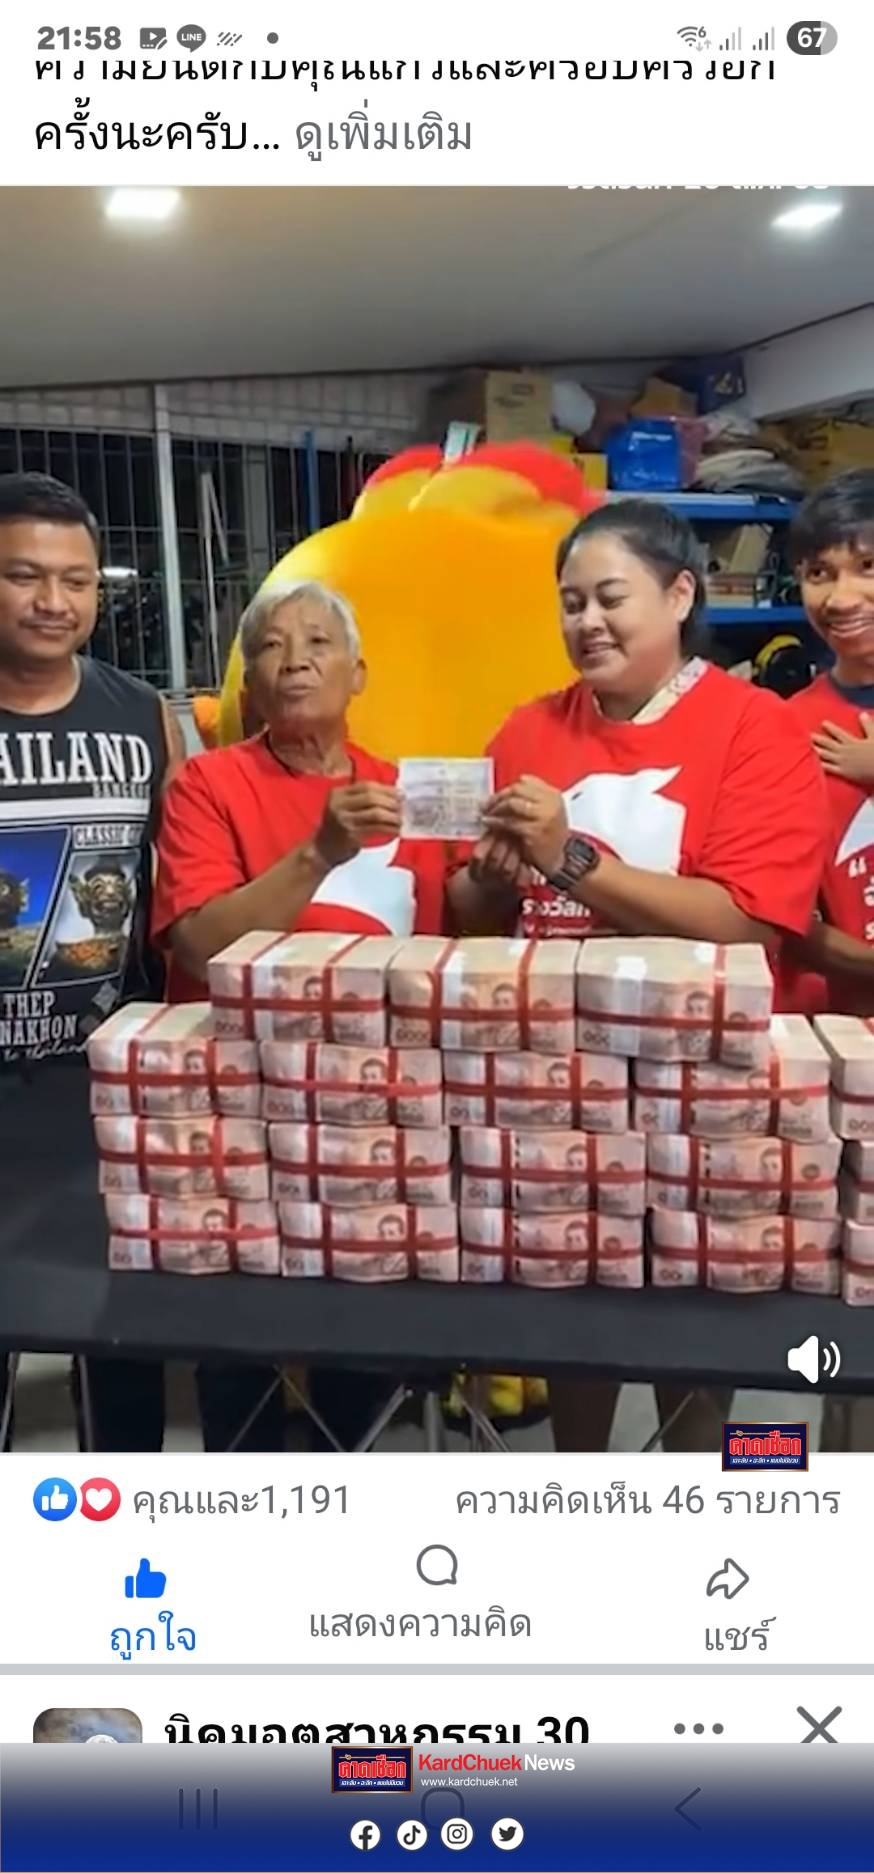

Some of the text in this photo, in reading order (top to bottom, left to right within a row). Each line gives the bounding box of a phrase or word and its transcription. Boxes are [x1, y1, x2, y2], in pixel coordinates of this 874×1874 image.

[37, 26, 121, 50] 21:58
[181, 33, 202, 41] LINE
[797, 27, 827, 48] 67
[35, 97, 471, 161] ครั้งนะครับ... ดูเพิ่มเติม
[3, 990, 56, 1018] THEP
[0, 1015, 77, 1046] NAKHON
[456, 1481, 840, 1514] ความคิดเห็น 46 รายการ
[110, 1610, 196, 1660] ถูกใจ
[309, 1605, 532, 1637] แสดงความคิด
[704, 1616, 777, 1651] แชร์
[164, 1713, 590, 1743] นิคมอตสาหกรรม 30
